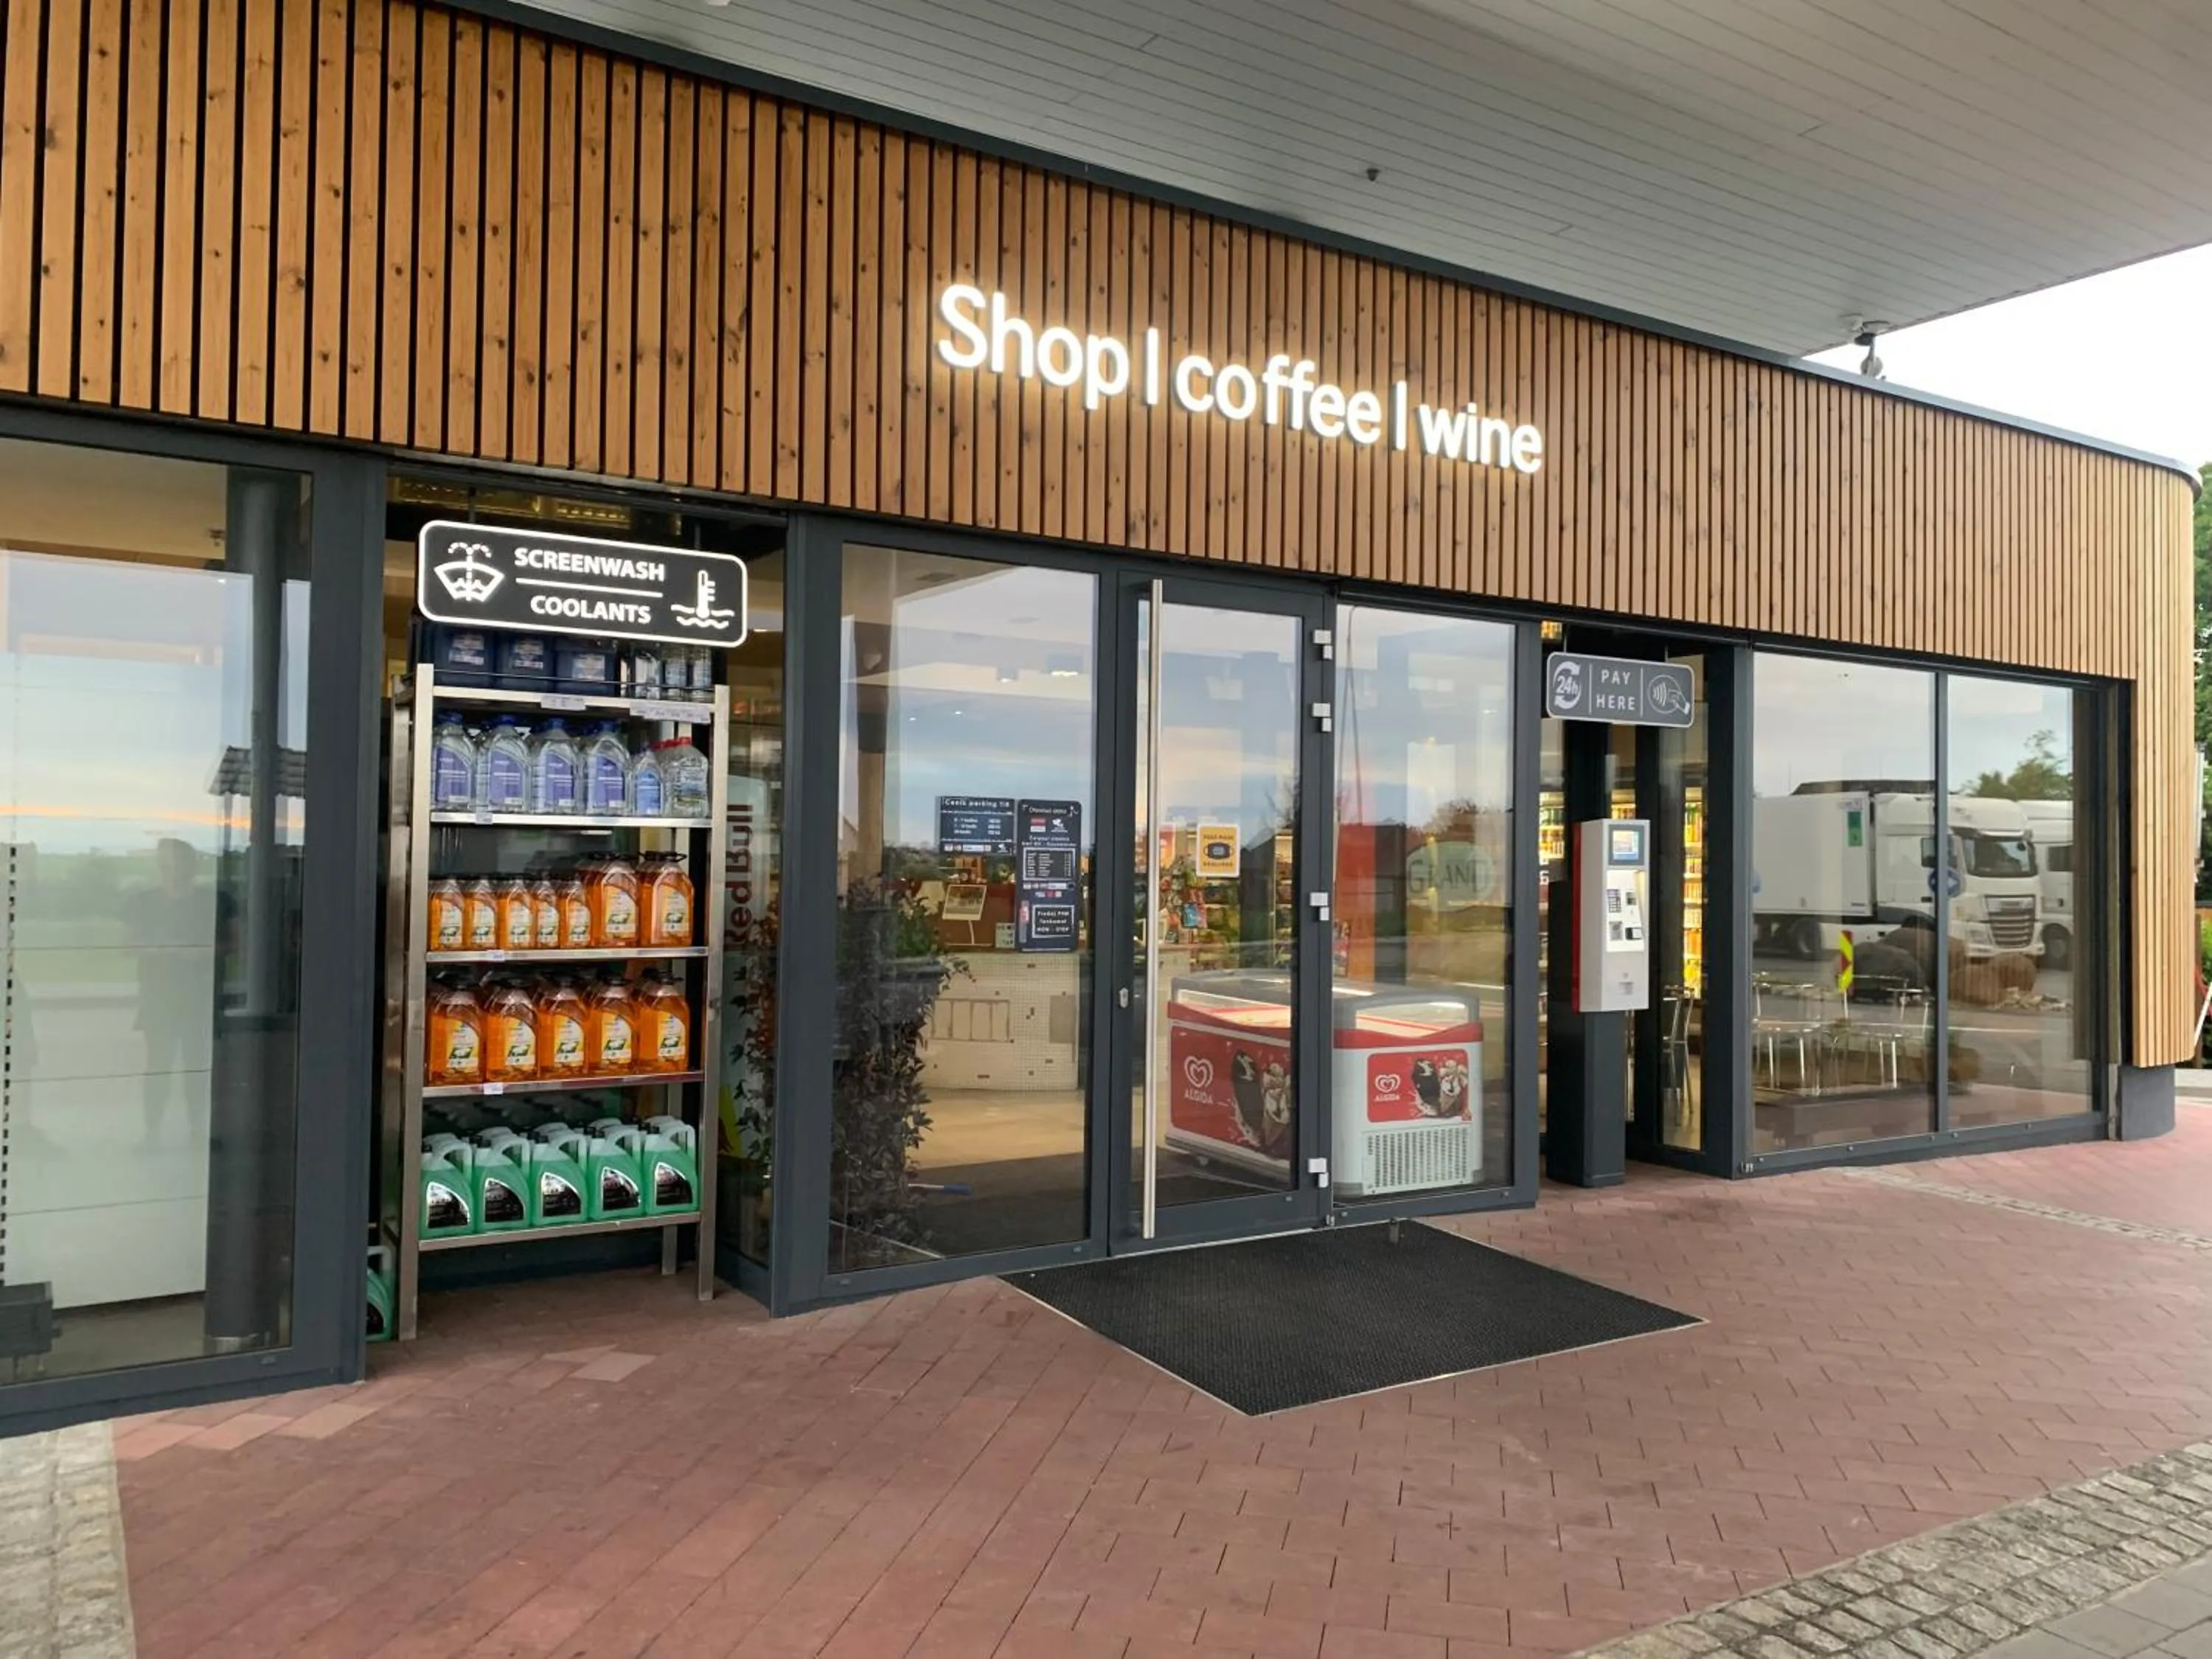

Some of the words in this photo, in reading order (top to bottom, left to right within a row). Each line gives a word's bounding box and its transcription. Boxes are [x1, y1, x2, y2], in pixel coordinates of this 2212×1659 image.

[937, 284, 1130, 411] Shop
[1175, 354, 1381, 444] coffee
[1417, 401, 1543, 474] wine
[515, 547, 665, 581] SCREENWASH
[530, 595, 651, 624] COOLANTS
[1601, 669, 1630, 685] PAY
[1596, 695, 1635, 710] HERE
[1184, 1088, 1214, 1105] ALGIDA
